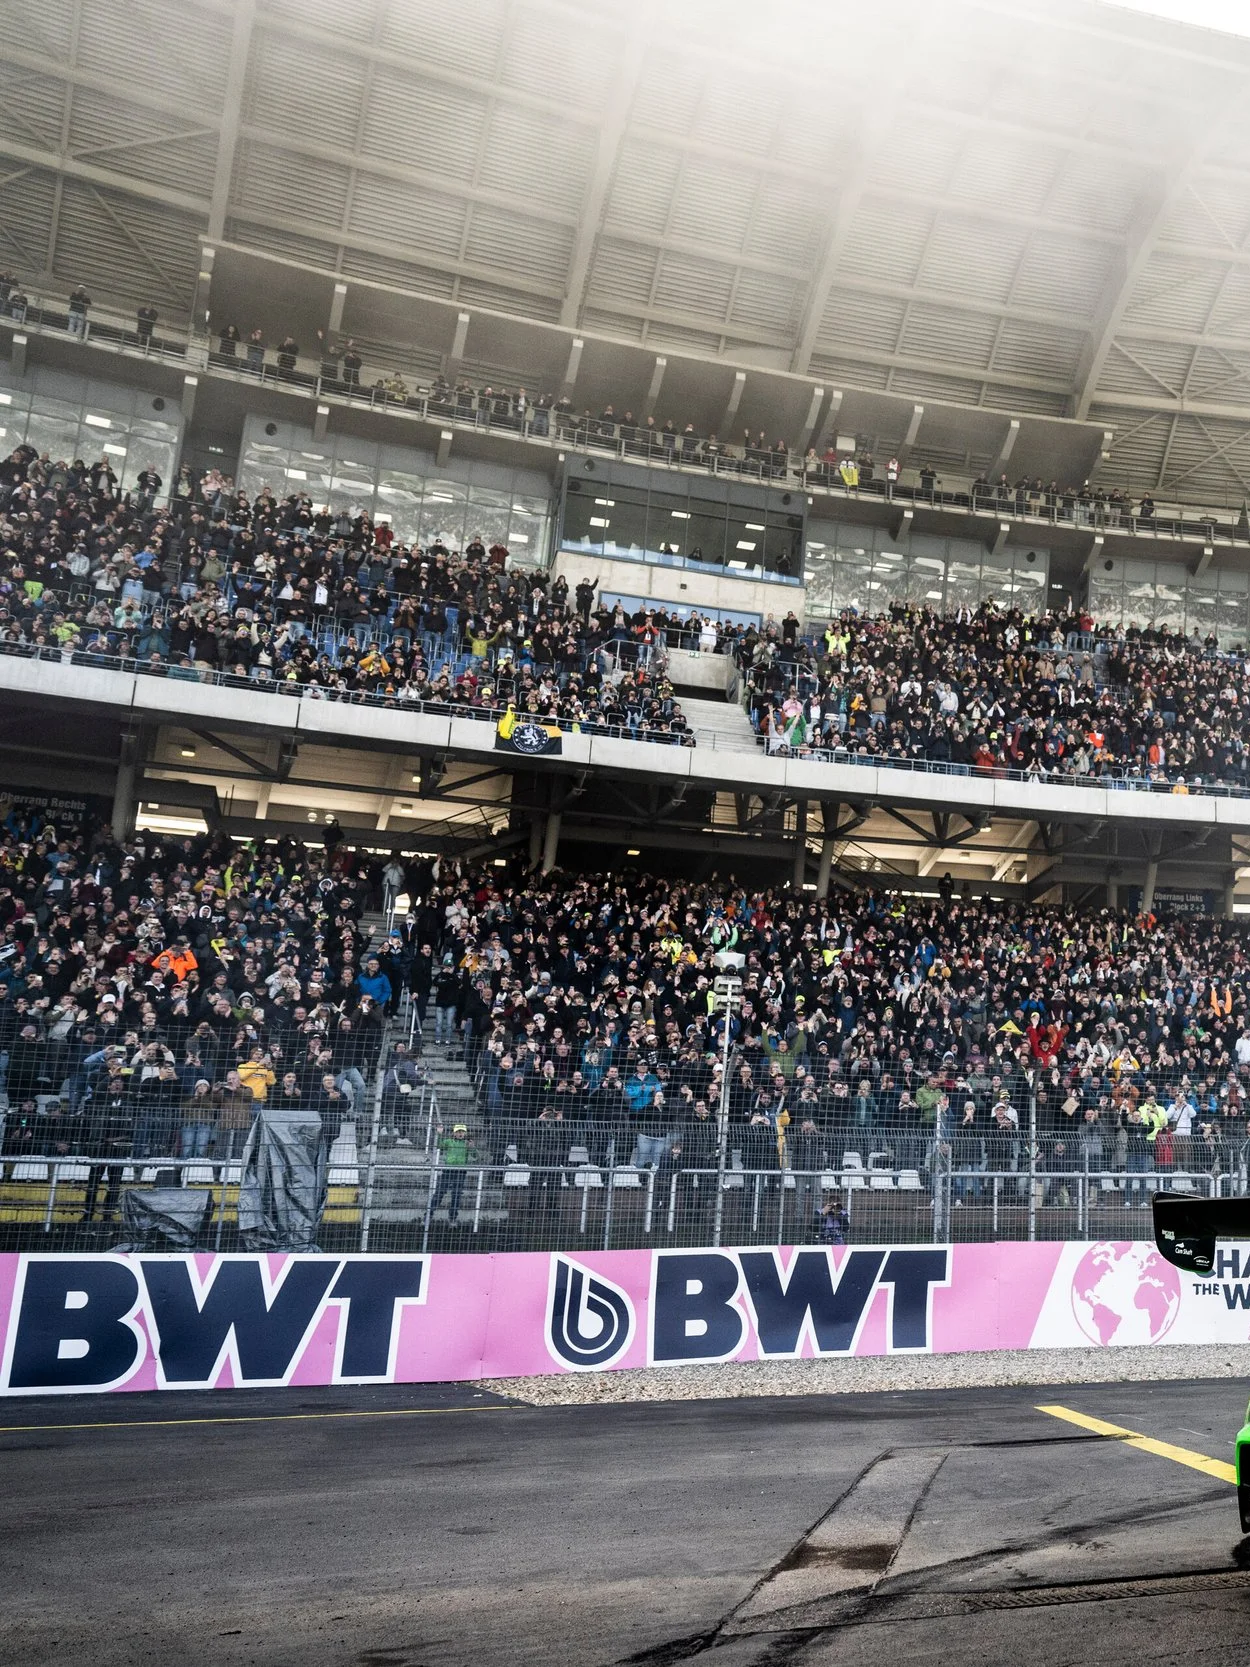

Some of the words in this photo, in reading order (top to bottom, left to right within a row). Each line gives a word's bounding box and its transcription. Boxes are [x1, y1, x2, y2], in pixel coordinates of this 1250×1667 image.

[45, 808, 74, 822] Blck
[652, 1248, 947, 1361] BWT
[1193, 1282, 1220, 1296] THE
[6, 1257, 425, 1390] BWT
